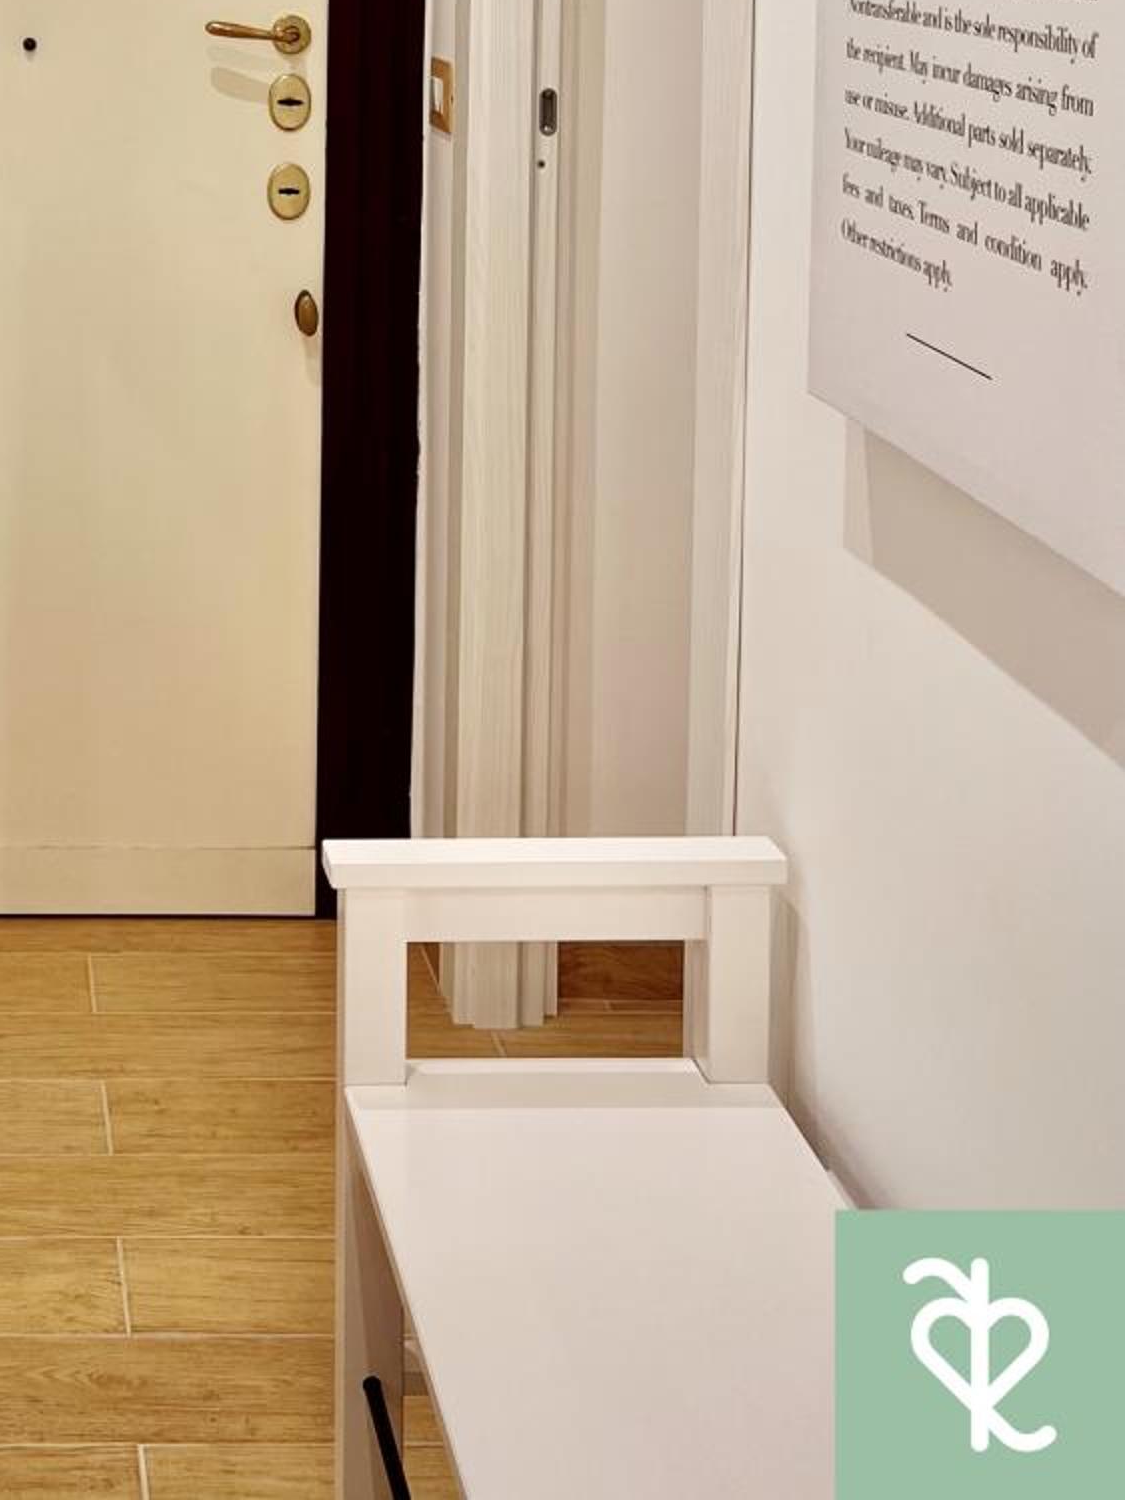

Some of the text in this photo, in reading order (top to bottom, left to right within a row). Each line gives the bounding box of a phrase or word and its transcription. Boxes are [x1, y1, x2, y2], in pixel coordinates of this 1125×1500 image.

[846, 37, 861, 60] the
[910, 49, 928, 85] May
[932, 54, 961, 84] incur
[962, 61, 1013, 103] damages
[1015, 75, 1058, 117] arising
[1061, 84, 1094, 117] from
[923, 6, 942, 29] and
[944, 7, 953, 31] is
[954, 8, 972, 34] the
[973, 13, 996, 38] sole
[997, 24, 1081, 65] responsibility
[1082, 31, 1099, 59] of
[844, 126, 866, 154] Your
[866, 137, 901, 173] mileage
[903, 154, 924, 182] may
[949, 161, 992, 201] Subject
[993, 181, 1007, 203] to
[1008, 182, 1023, 209] all
[1024, 192, 1090, 231] applicable
[845, 89, 1092, 182] use or misuse. Additional parts sold separately.
[841, 217, 953, 292] Other restrictions apply.
[842, 171, 860, 198] fees
[864, 185, 884, 208] and
[917, 199, 950, 234] Terms
[956, 221, 978, 245] and
[984, 235, 1042, 271] condition
[1050, 259, 1088, 296] apply.
